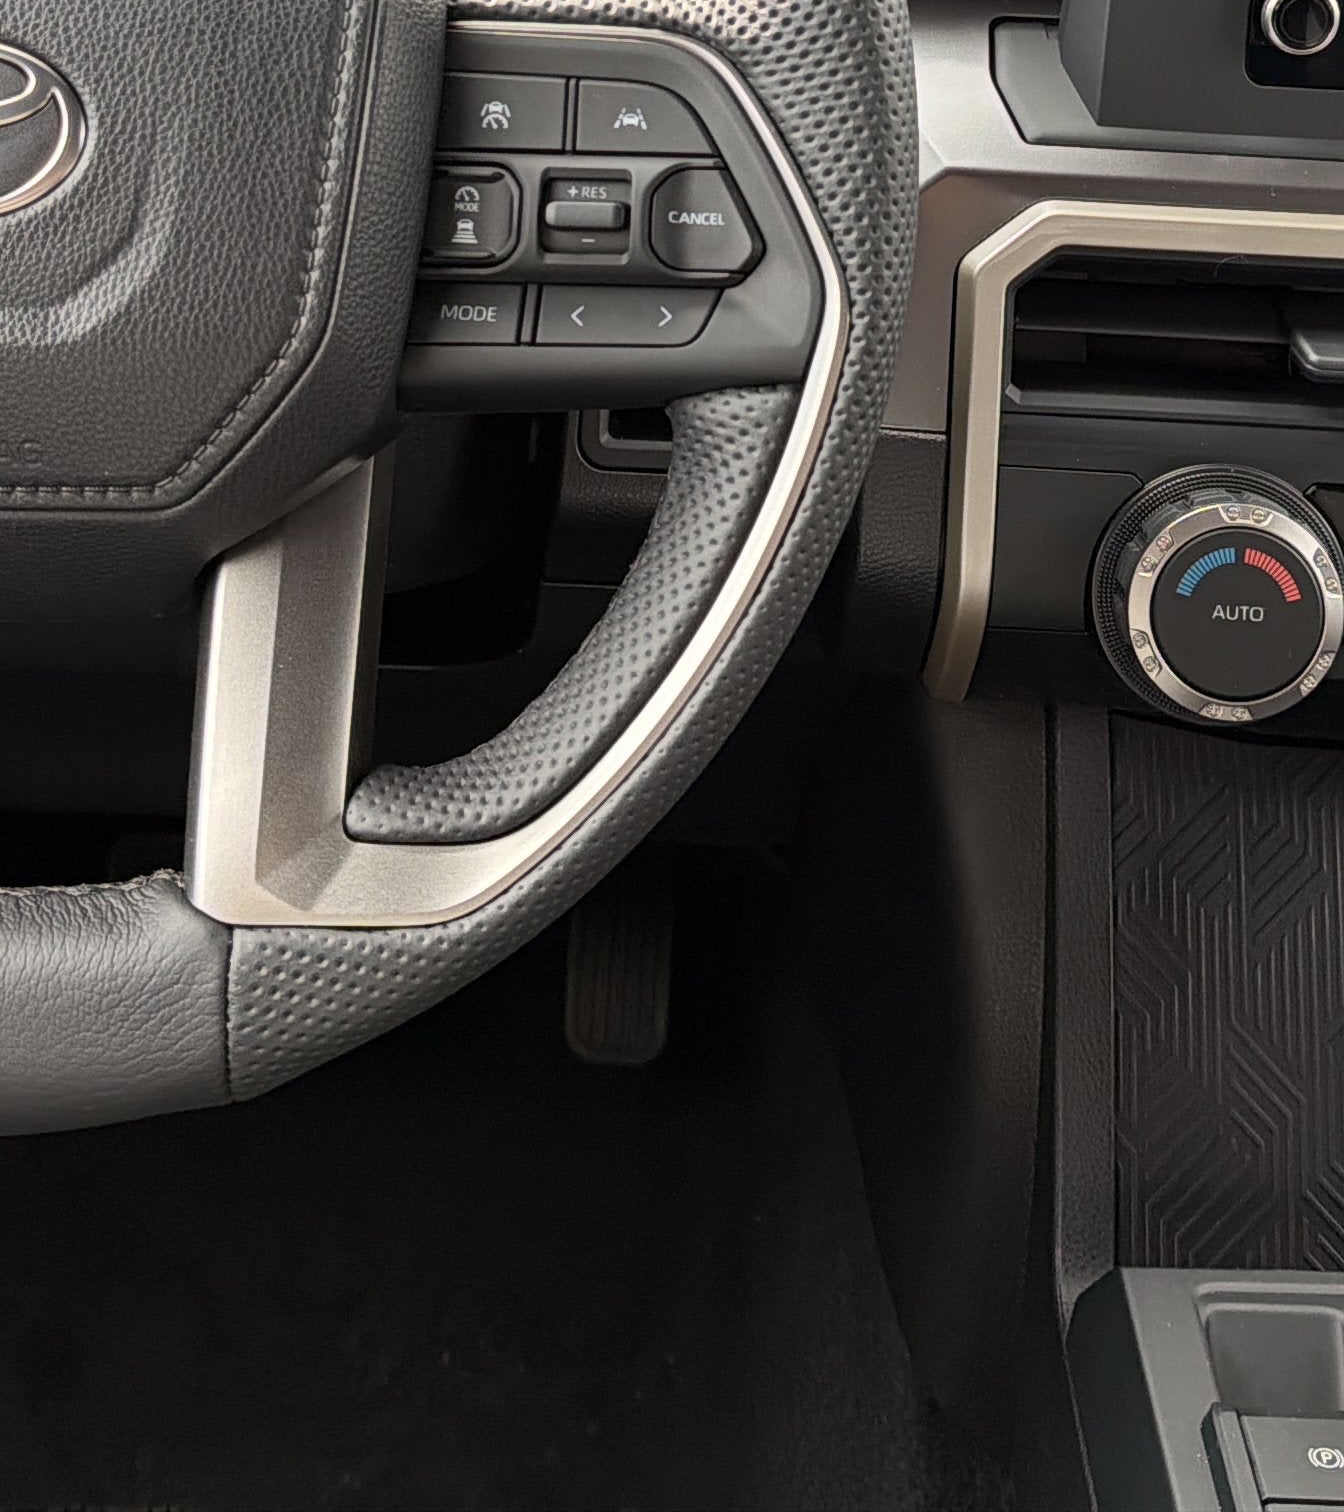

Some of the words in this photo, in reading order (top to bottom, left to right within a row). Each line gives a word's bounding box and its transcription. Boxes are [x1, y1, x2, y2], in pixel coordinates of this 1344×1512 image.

[454, 202, 480, 213] MODE
[668, 210, 725, 226] CANCEL
[440, 304, 497, 322] MODE
[1211, 604, 1264, 622] AUTO
